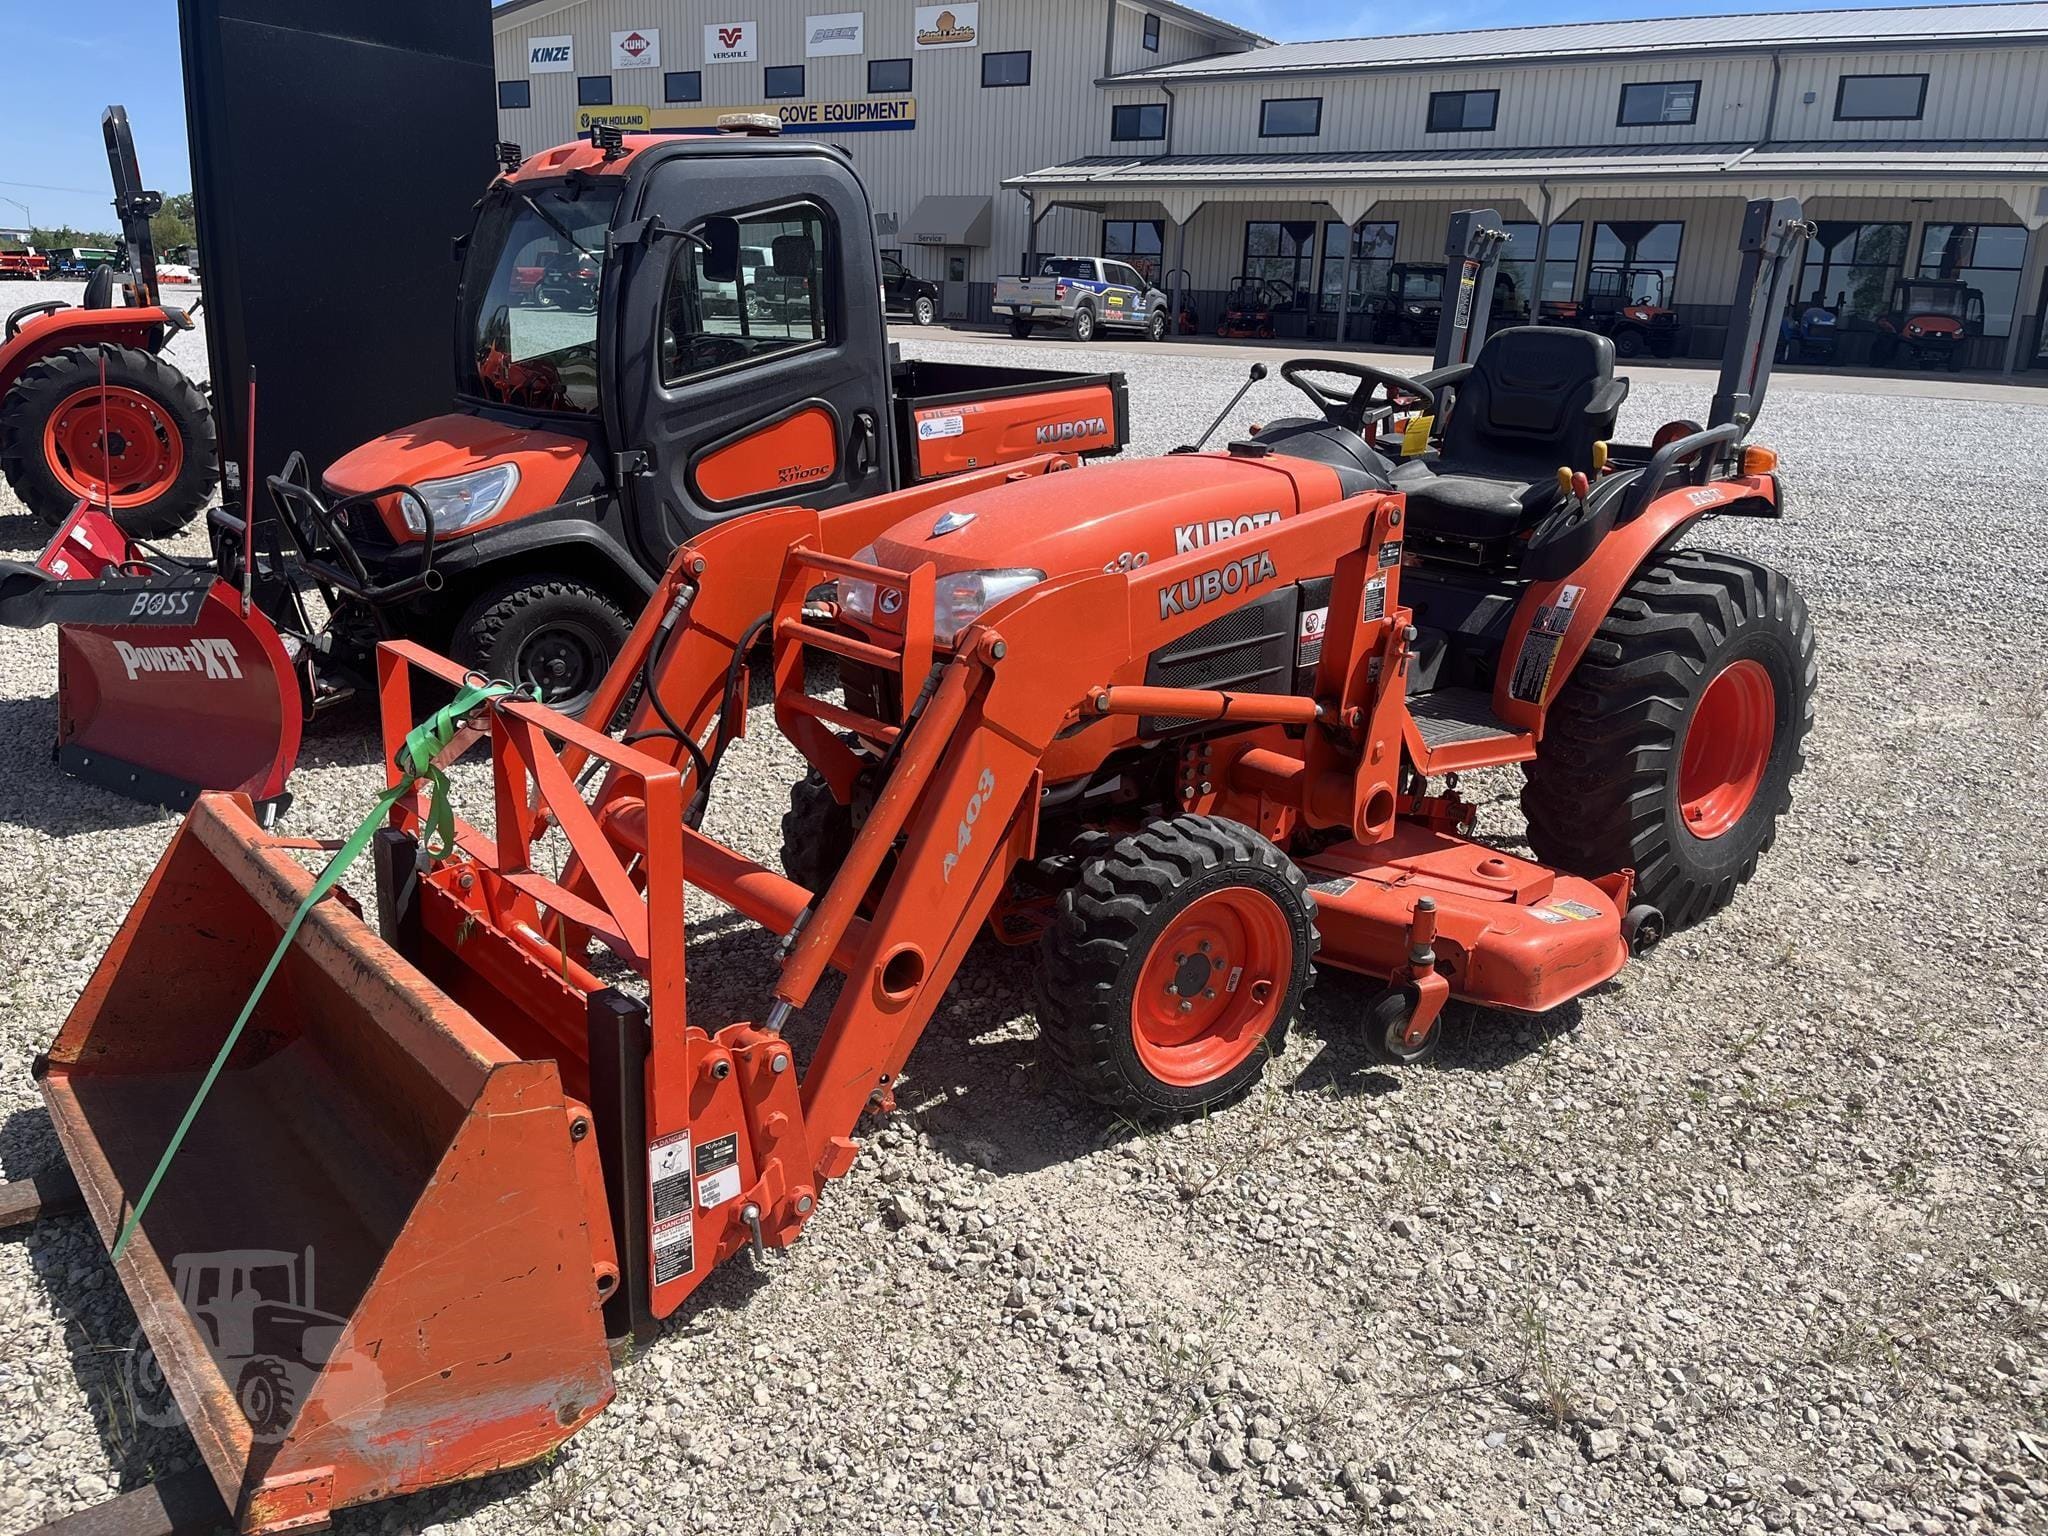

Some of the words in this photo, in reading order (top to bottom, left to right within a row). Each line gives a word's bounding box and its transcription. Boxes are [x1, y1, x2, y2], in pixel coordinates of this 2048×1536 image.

[624, 39, 647, 50] KUHN
[531, 46, 570, 63] KINZE
[713, 50, 748, 58] VERSATILE
[591, 116, 608, 125] NEW
[609, 115, 643, 125] HOLLAND
[779, 105, 818, 123] COVE
[824, 101, 908, 122] EQUIPMENT
[918, 234, 942, 242] Service
[922, 405, 983, 419] DIESEL
[1036, 417, 1107, 444] KUBOTA
[777, 465, 830, 485] X1100C
[778, 464, 801, 476] RTV
[1158, 550, 1277, 621] KUBOTA
[129, 591, 194, 616] BOSS
[943, 768, 995, 885] A403
[659, 1131, 688, 1147] DANGER
[661, 1215, 690, 1230] DANGER
